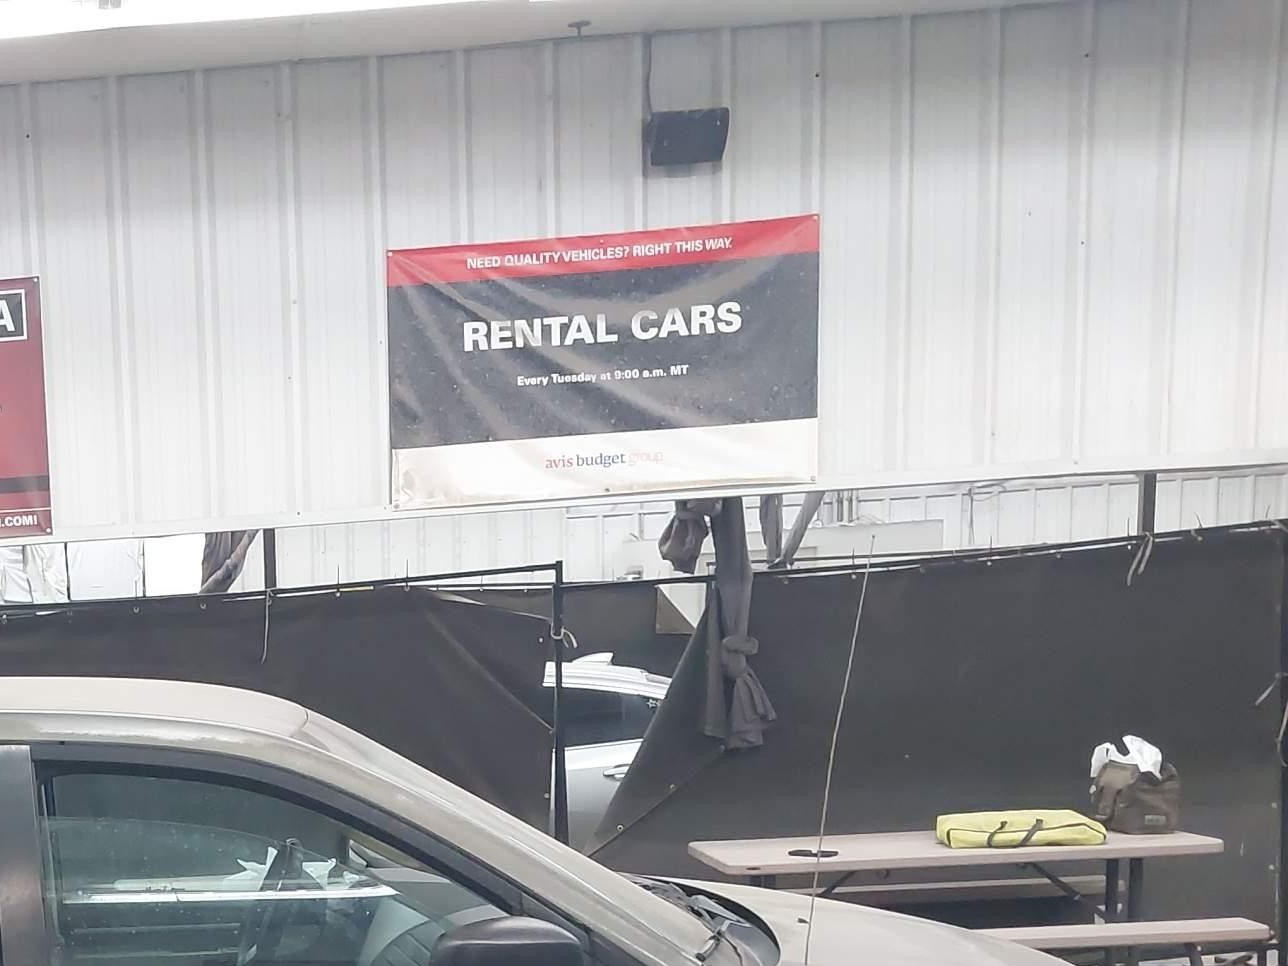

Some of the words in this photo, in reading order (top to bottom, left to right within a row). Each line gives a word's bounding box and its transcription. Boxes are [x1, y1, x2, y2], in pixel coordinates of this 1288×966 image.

[466, 256, 501, 269] NEED
[504, 251, 562, 267] QUALITY
[562, 246, 630, 263] VEHICLES?
[632, 242, 672, 257] RIGHT
[674, 239, 703, 254] THIS
[463, 313, 618, 352] RENTAL
[631, 301, 743, 340] CARS
[517, 375, 548, 387] Every
[551, 371, 597, 383] Tuesday
[600, 372, 611, 380] at
[614, 368, 639, 379] 9:00
[643, 367, 667, 378] a.m.
[670, 364, 689, 375] MT
[545, 454, 574, 469] avis
[576, 452, 627, 468] budget
